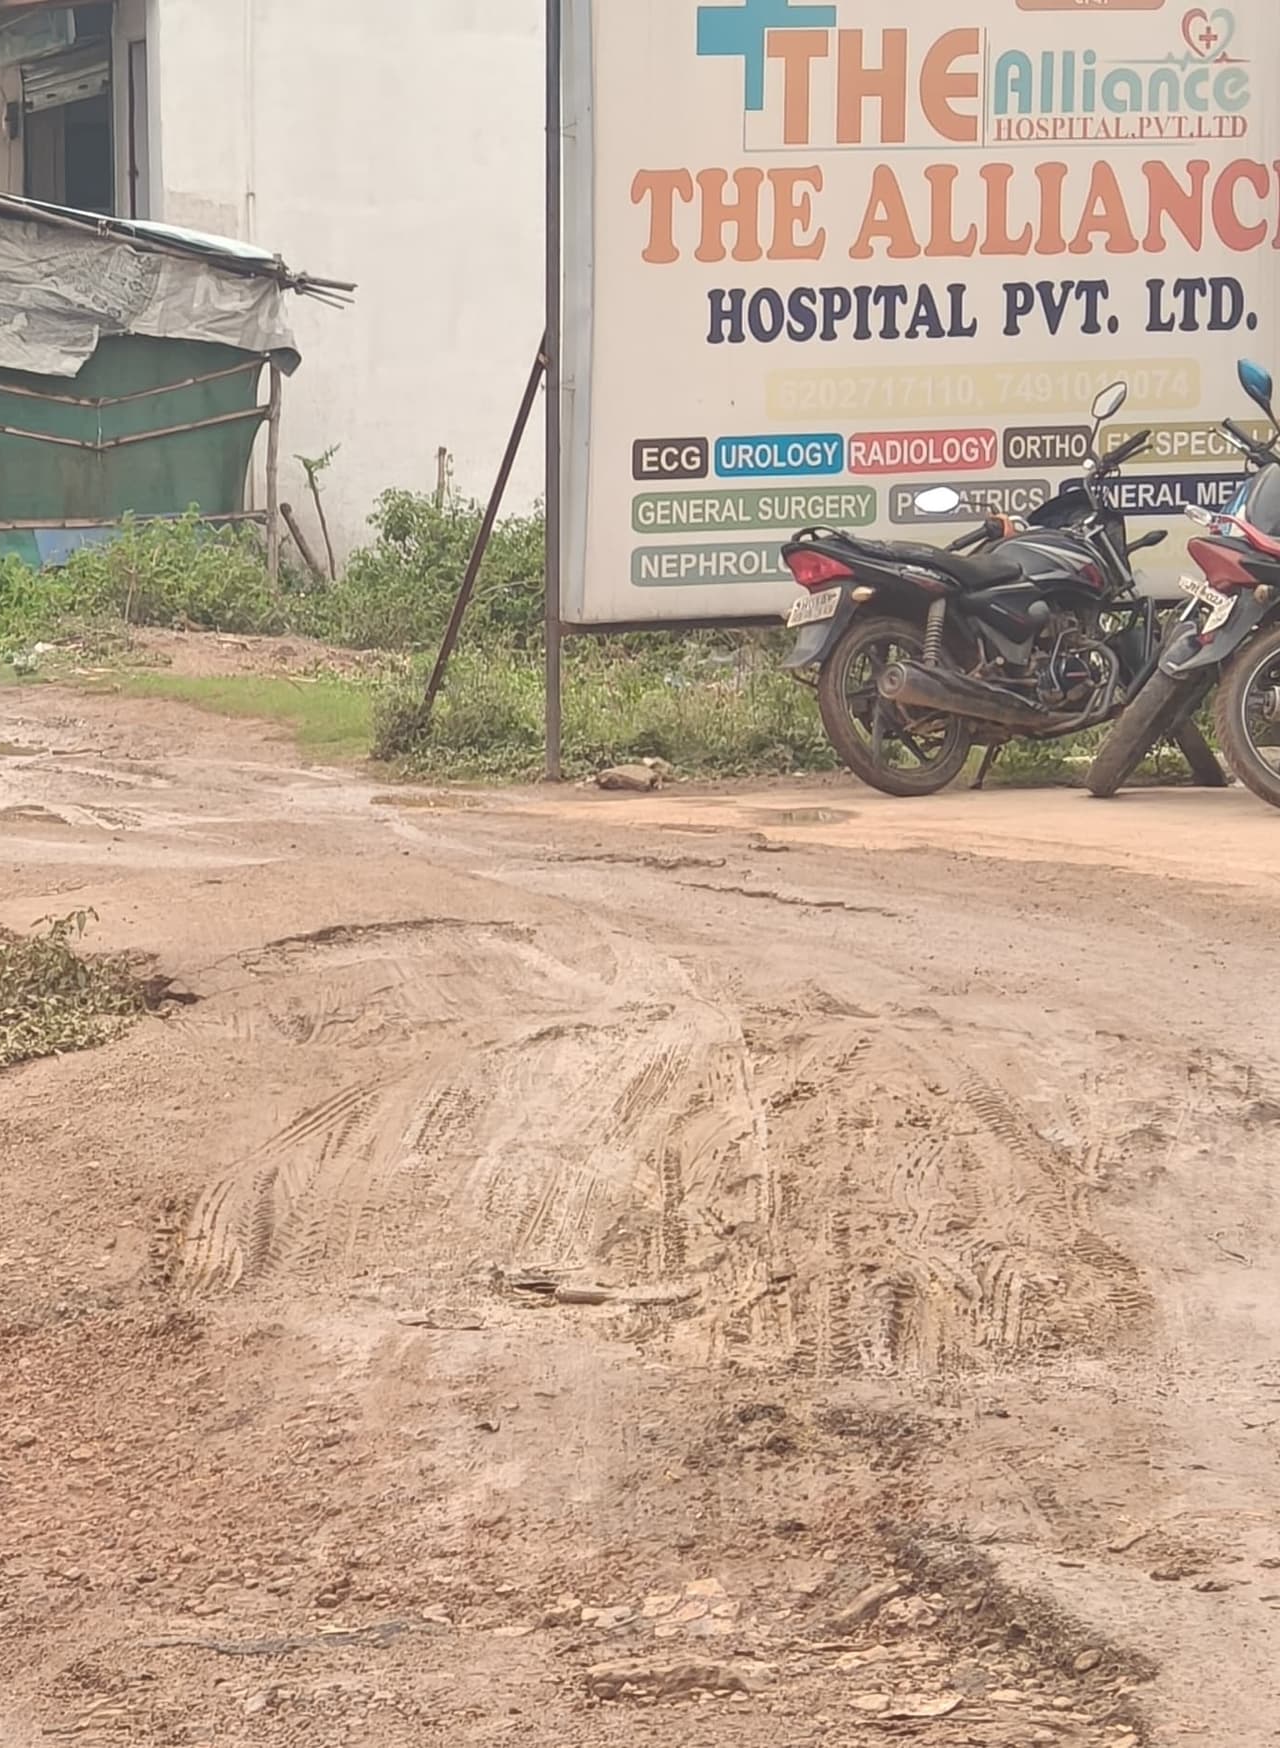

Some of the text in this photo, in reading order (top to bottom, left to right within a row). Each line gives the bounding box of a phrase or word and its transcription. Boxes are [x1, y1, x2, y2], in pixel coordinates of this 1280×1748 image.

[766, 27, 980, 145] THE
[993, 49, 1251, 115] Alliance
[630, 158, 1280, 263] THE ALLIANC
[705, 275, 1260, 345] HOSPITAL PVT. LTD.
[641, 445, 702, 472] ECG
[721, 440, 839, 469] UROLOGY
[851, 436, 996, 467] RADIOLOGY
[1008, 433, 1087, 459] ORTHO
[638, 493, 871, 525] GENERAL SURGERY
